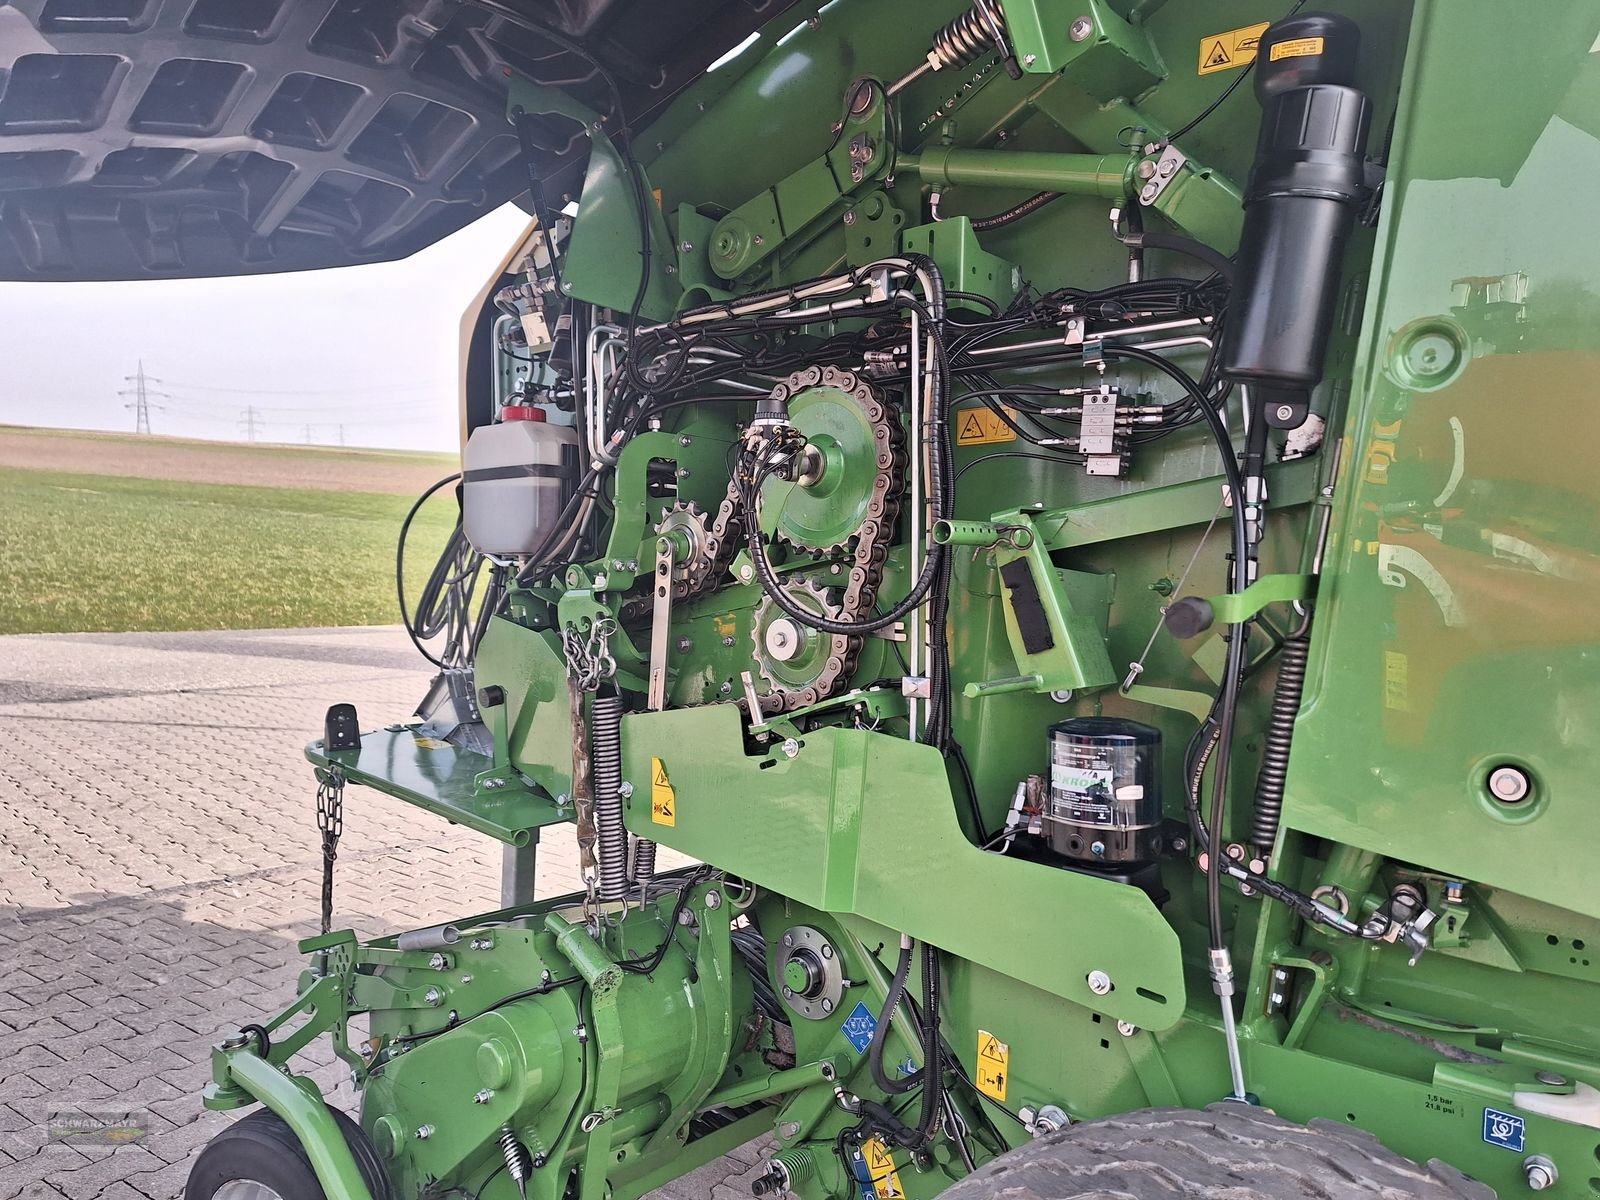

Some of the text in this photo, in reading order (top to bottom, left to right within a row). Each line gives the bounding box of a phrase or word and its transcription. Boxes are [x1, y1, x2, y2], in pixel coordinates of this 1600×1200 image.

[1192, 762, 1205, 793] MUELLER
[1201, 739, 1216, 762] RHEINE
[1439, 1096, 1453, 1106] bar
[1442, 1106, 1455, 1115] psi
